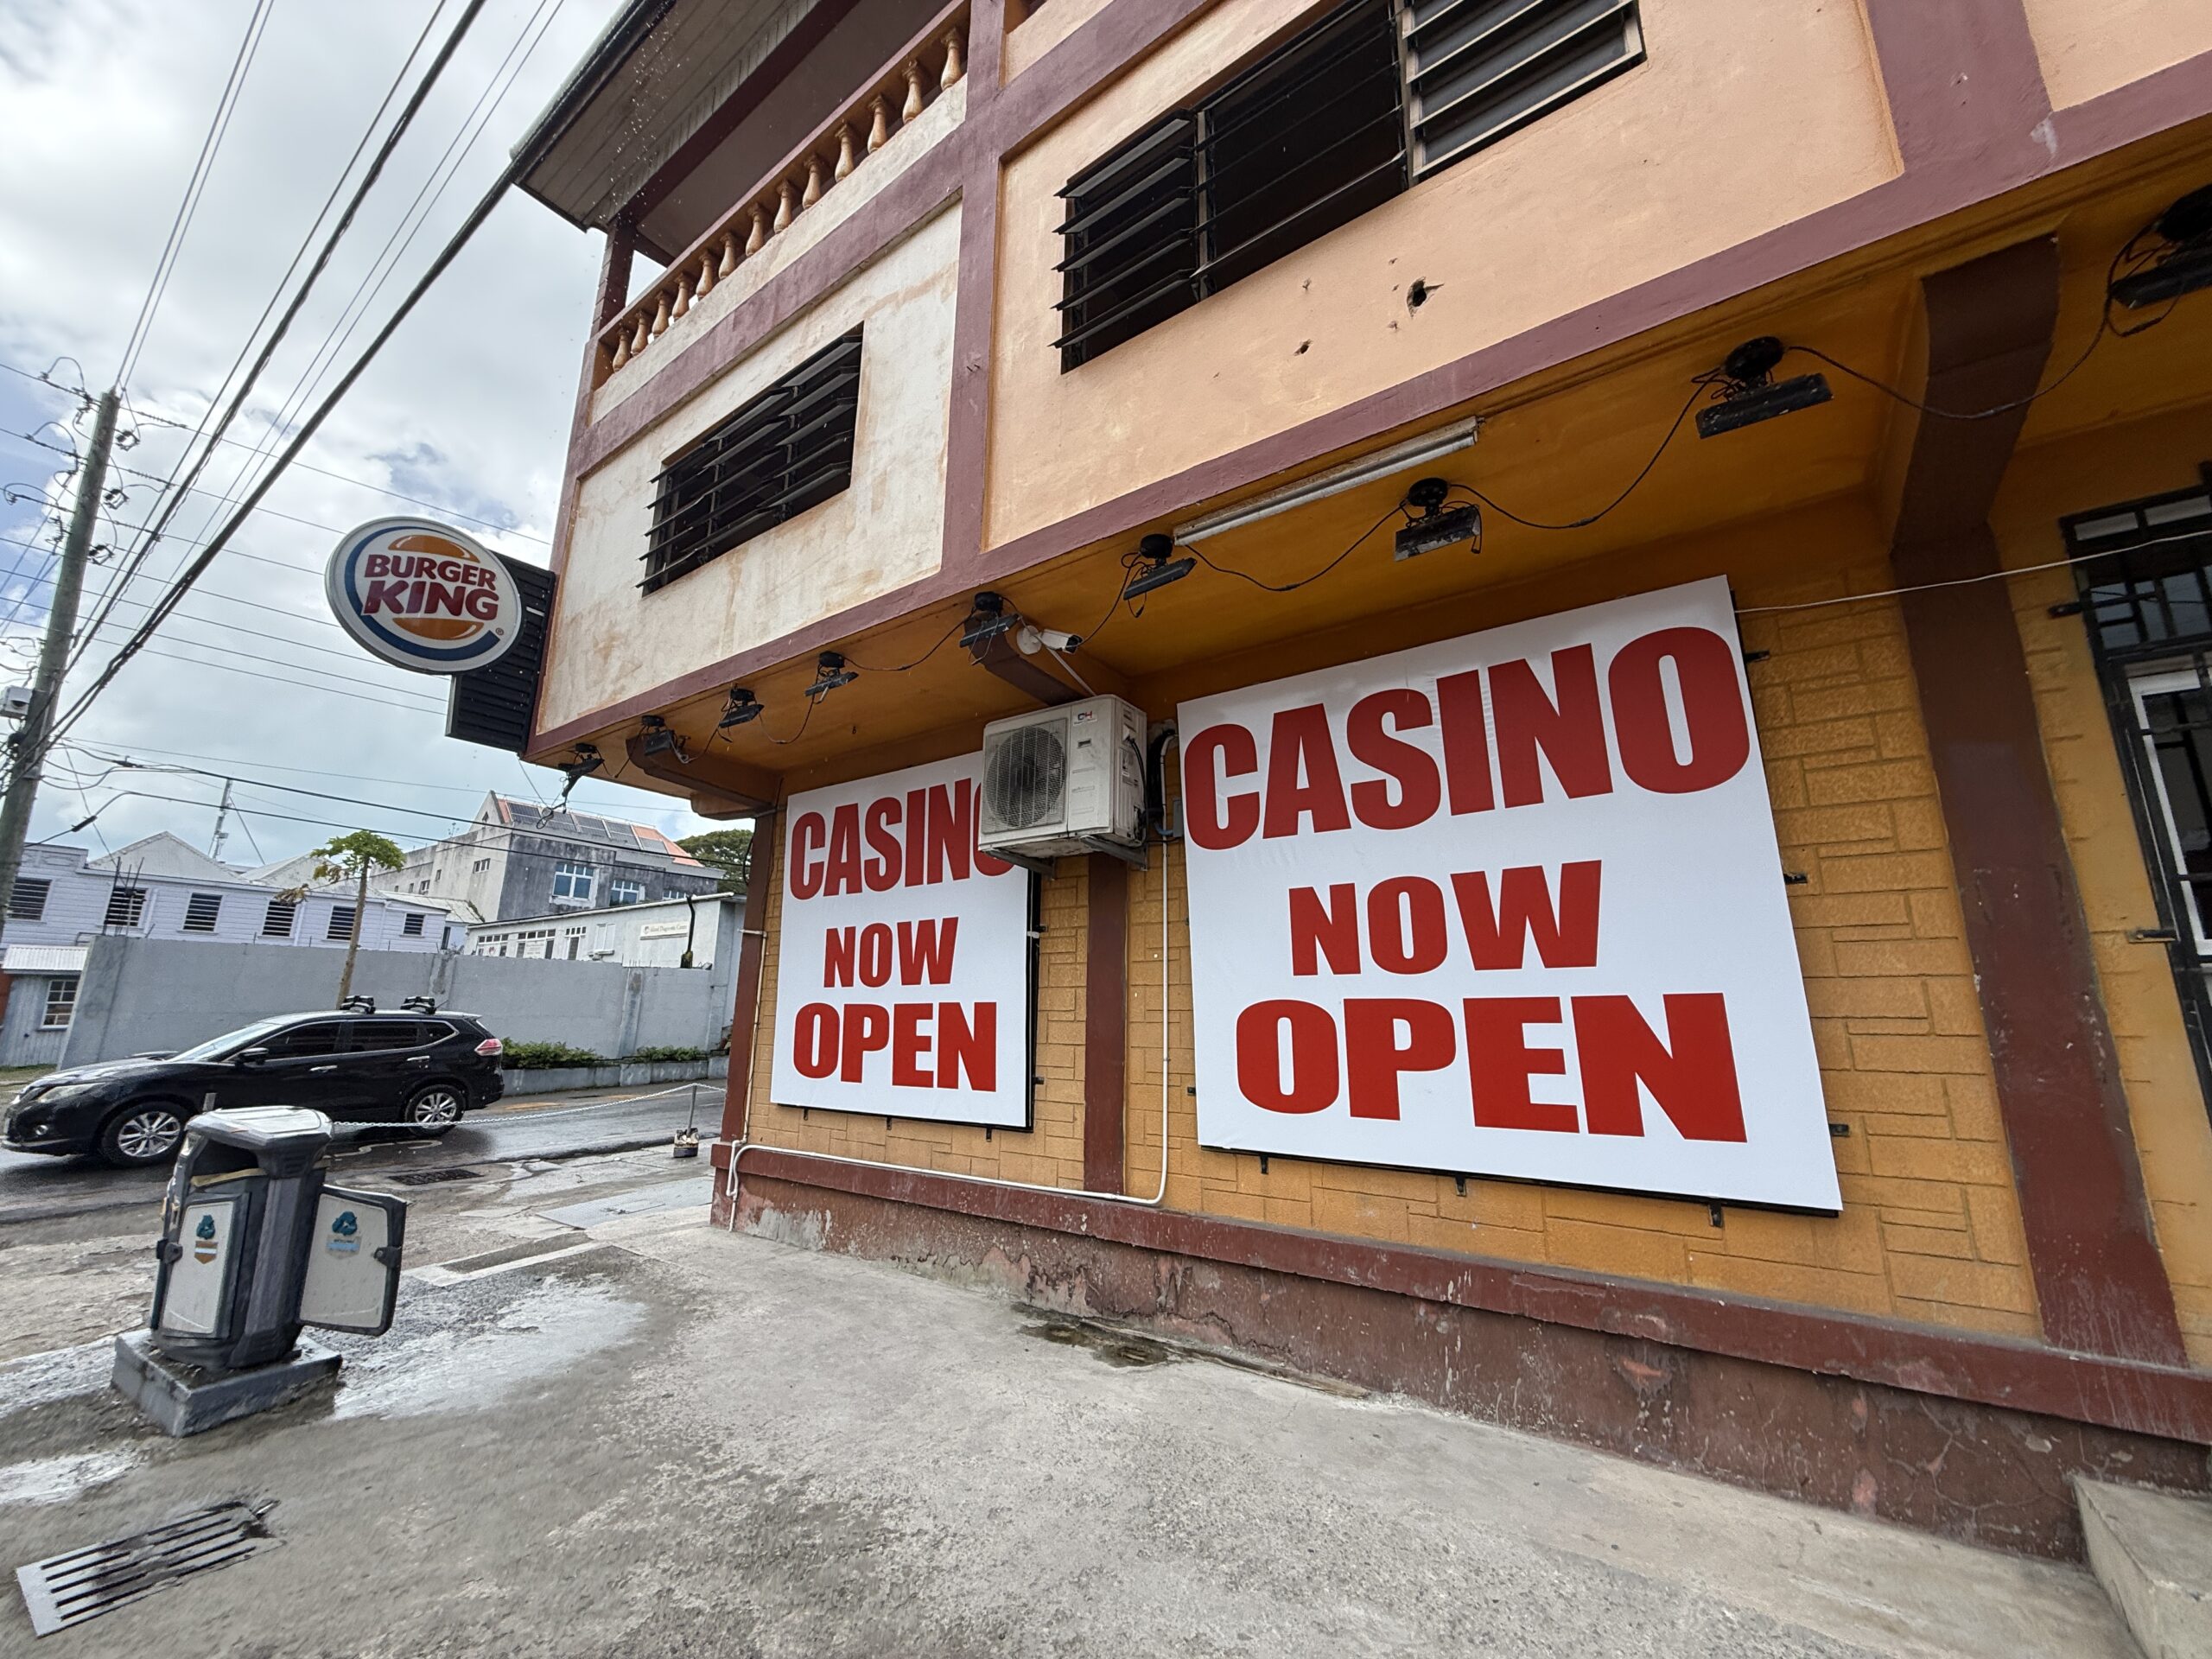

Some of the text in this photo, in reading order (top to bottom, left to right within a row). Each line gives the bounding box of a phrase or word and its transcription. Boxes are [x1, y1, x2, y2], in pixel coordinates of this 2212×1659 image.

[363, 580, 499, 621] KING
[364, 554, 497, 591] BURGER
[1184, 626, 1751, 851] CASINO
[823, 916, 960, 988] NOW
[1288, 860, 1603, 976] NOW
[792, 1001, 998, 1093] OPEN
[1236, 992, 1749, 1144] OPEN
